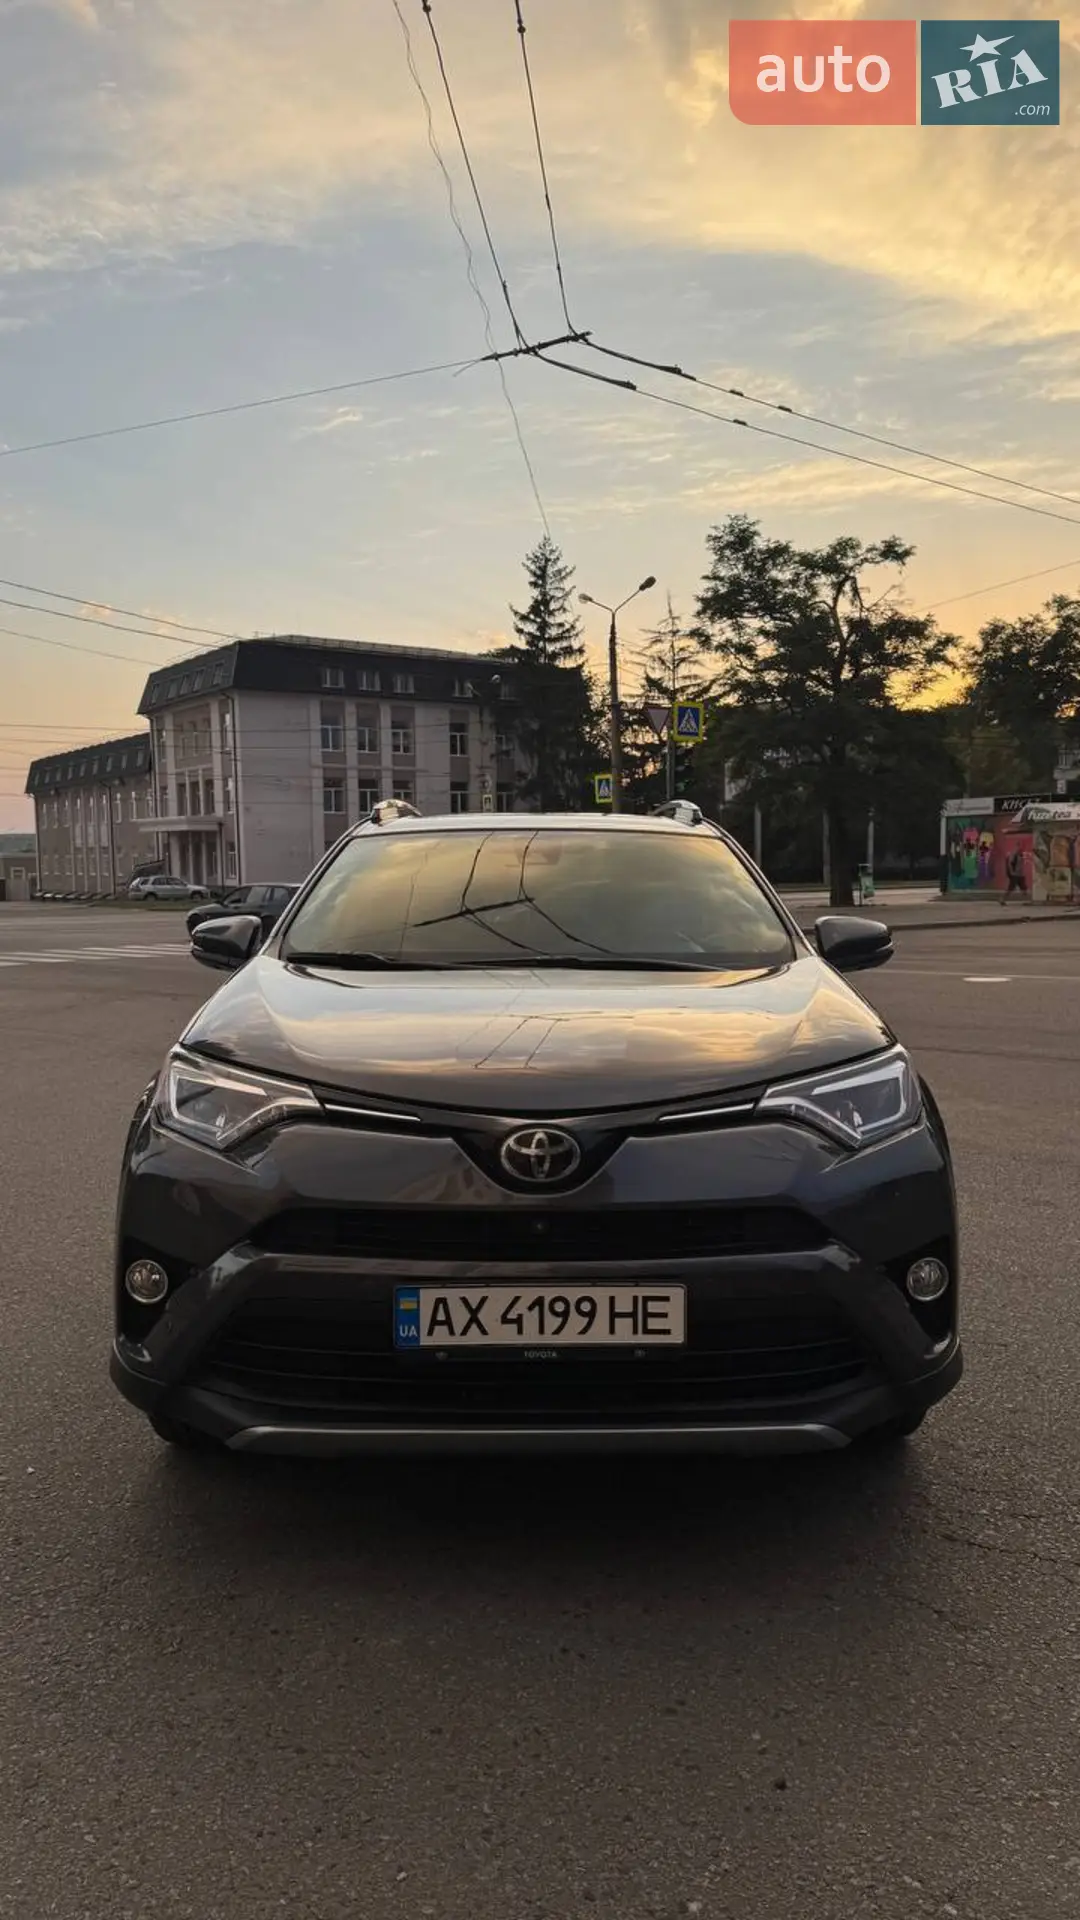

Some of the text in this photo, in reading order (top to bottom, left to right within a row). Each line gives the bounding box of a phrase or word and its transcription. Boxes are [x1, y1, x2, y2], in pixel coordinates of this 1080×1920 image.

[426, 1295, 672, 1336] AX 4199 HE
[399, 1325, 418, 1337] UA
[524, 1350, 558, 1358] TOYOTA
